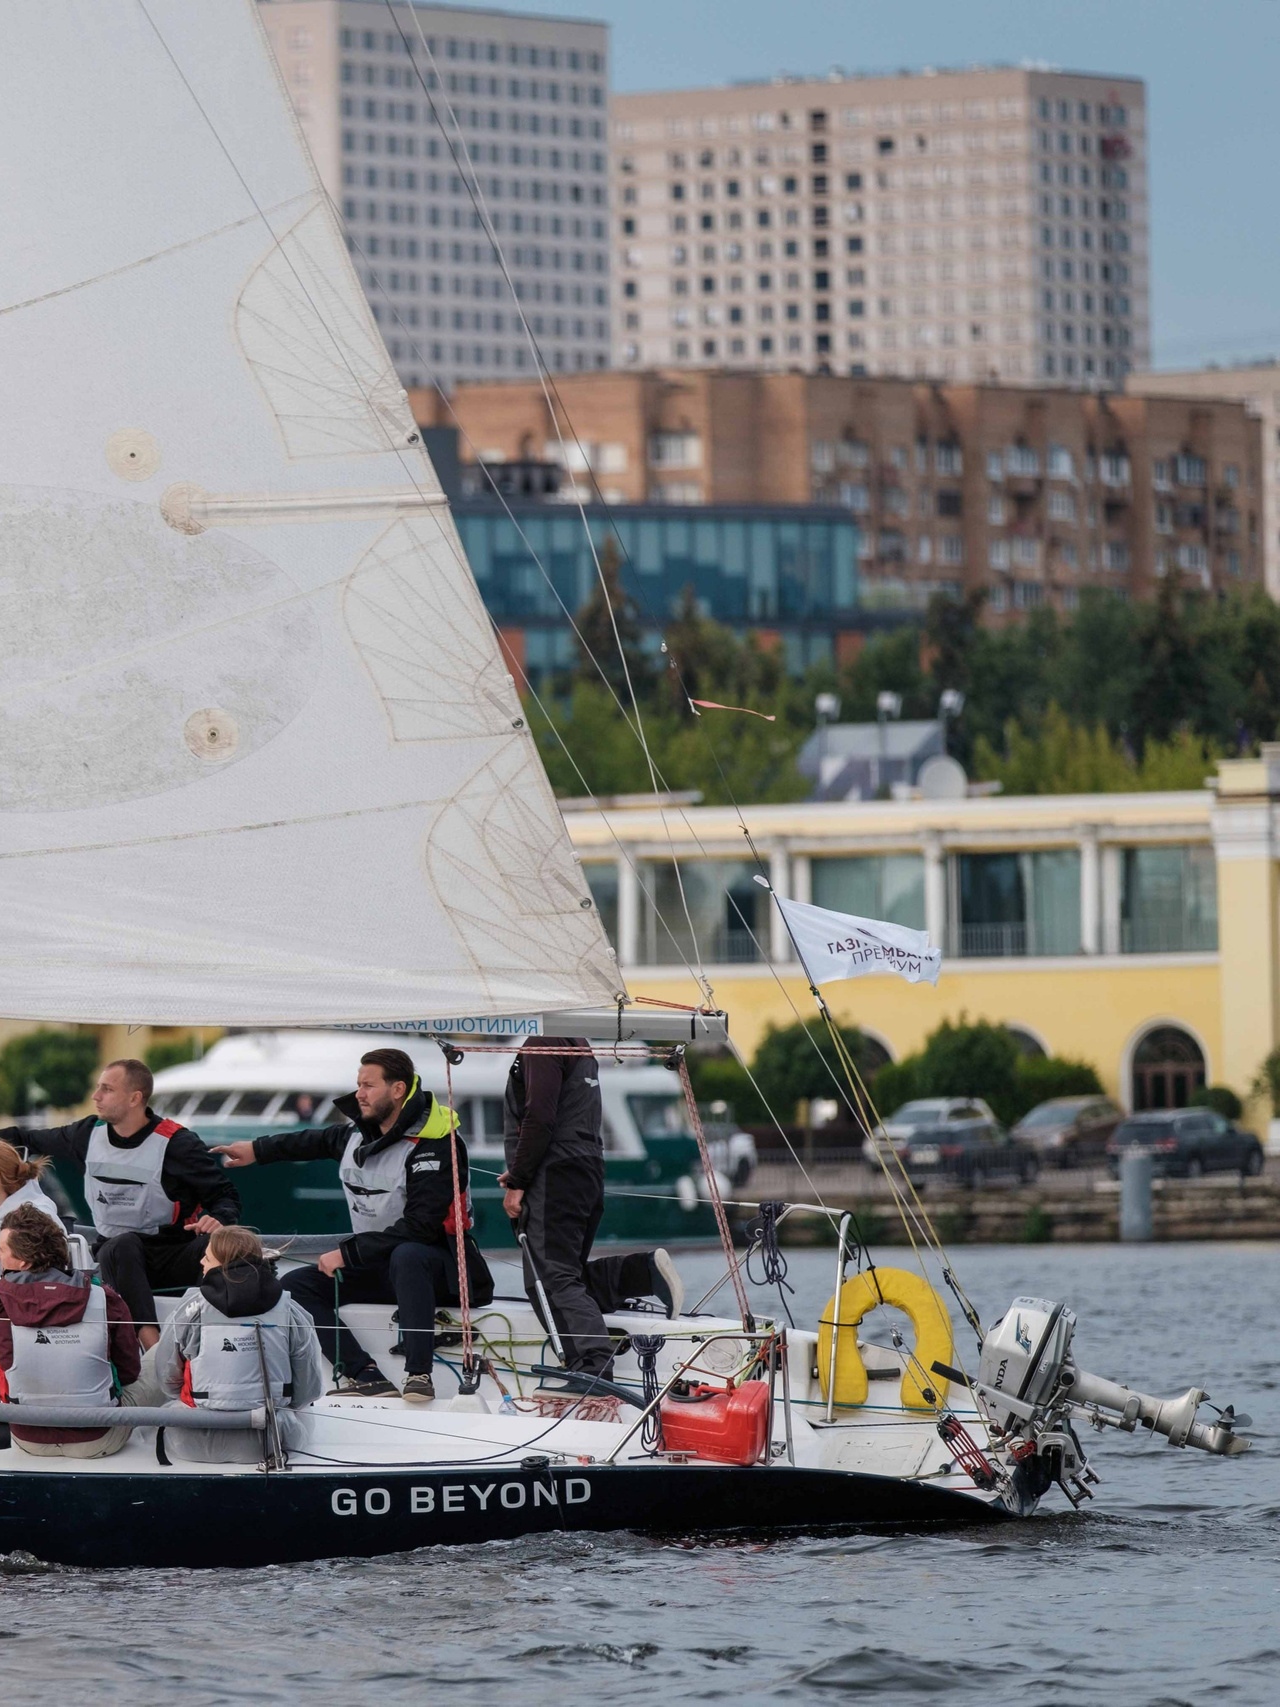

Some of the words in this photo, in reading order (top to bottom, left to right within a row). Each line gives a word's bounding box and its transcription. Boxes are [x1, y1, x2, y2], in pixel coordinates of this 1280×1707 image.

[433, 1017, 539, 1035] ФЛОТИЛИЯ
[989, 1358, 1009, 1410] HNDA
[330, 1487, 391, 1516] GO
[410, 1478, 592, 1513] BEYOND
